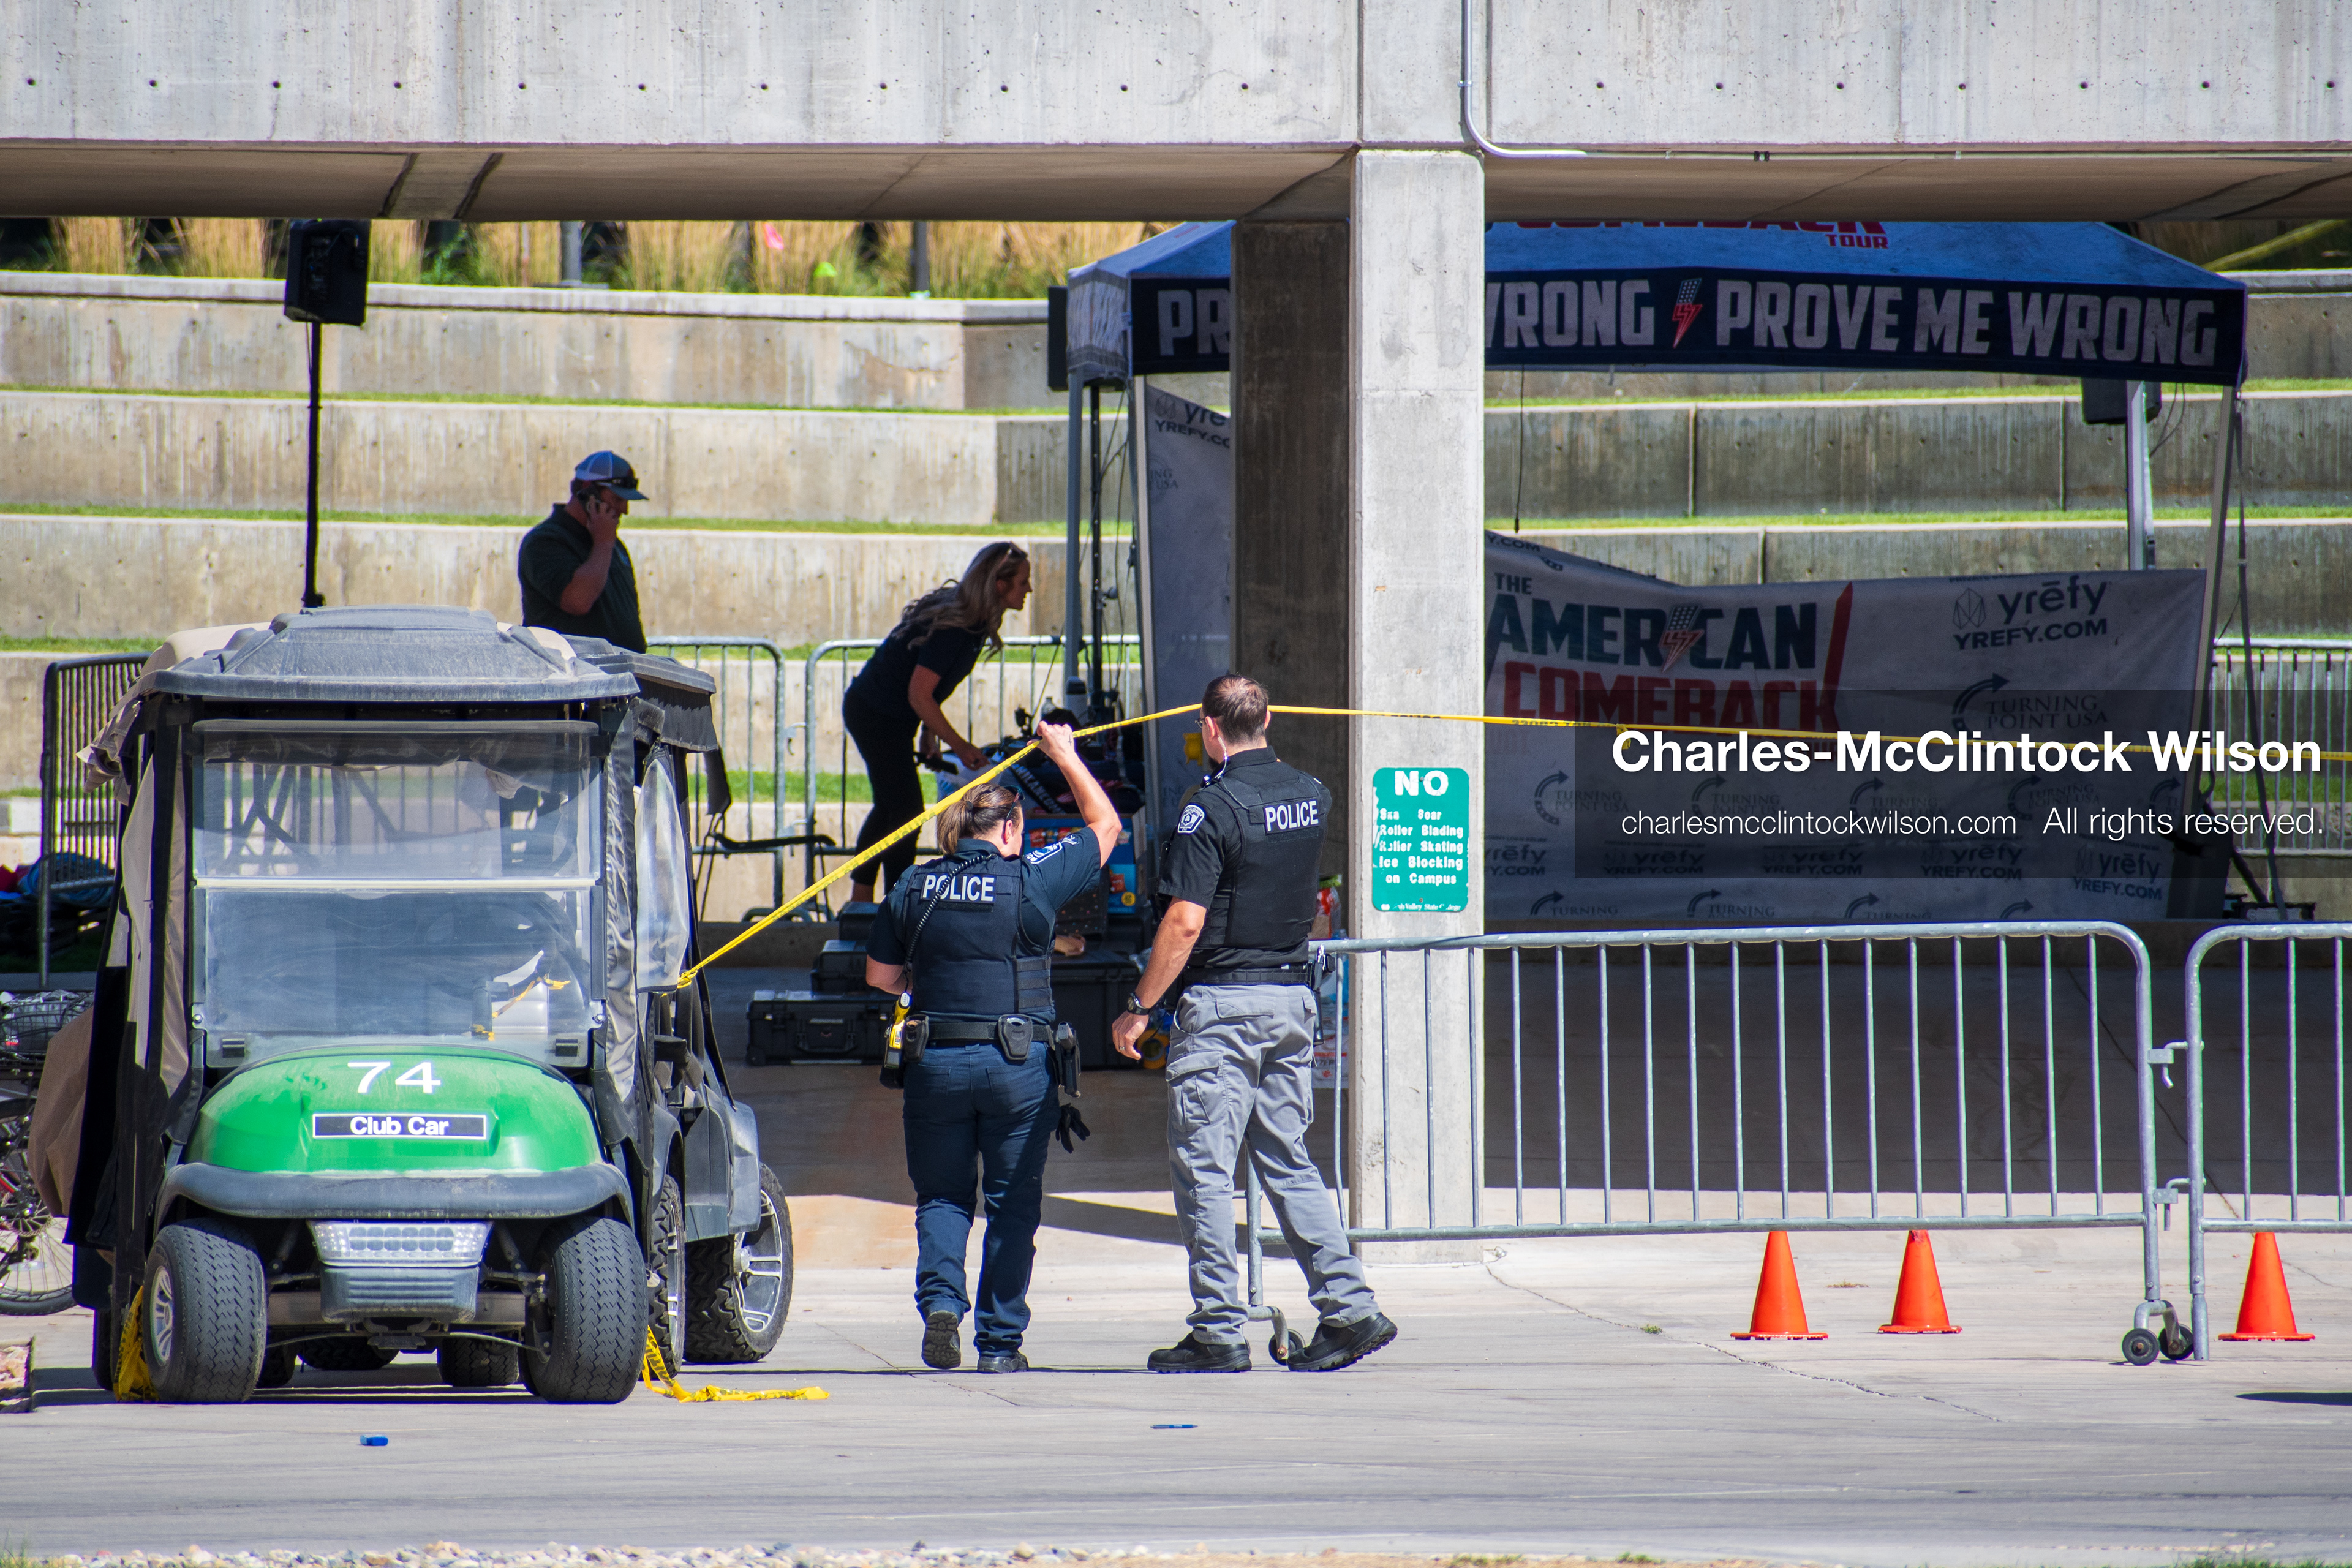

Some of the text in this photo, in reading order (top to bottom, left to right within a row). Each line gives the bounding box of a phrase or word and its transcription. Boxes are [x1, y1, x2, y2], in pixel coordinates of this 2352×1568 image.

[1825, 234, 1888, 249] TOUR
[1717, 279, 2217, 366] PROVE ME WRONG
[1155, 419, 1230, 448] YREFY.CO
[1494, 572, 1532, 595] THE
[1953, 618, 2107, 650] YREFY.COM
[1504, 649, 1844, 738] COMEBACK
[1986, 694, 2098, 714] TURNING
[1987, 710, 2108, 729] POINT USA
[1395, 771, 1449, 796] NO
[1555, 790, 1623, 801] TURNING
[1711, 793, 1781, 805] TURNING
[1265, 800, 1319, 832] POLICE
[1602, 801, 1630, 812] USA
[1379, 824, 1463, 839] Roller Blading
[1420, 840, 1463, 854] Skating
[1379, 856, 1463, 870] Ice Blocking
[1485, 865, 1545, 876] Y.COM
[1921, 865, 2022, 880] YREFY.COM
[922, 874, 995, 902] POLICE
[1385, 873, 1457, 886] on Campus
[2072, 876, 2163, 900] YREFY.COM
[1551, 905, 1619, 916] TURNING
[1708, 903, 1775, 917] TURNING
[347, 1061, 441, 1094] 74
[350, 1116, 449, 1136] Club Car
